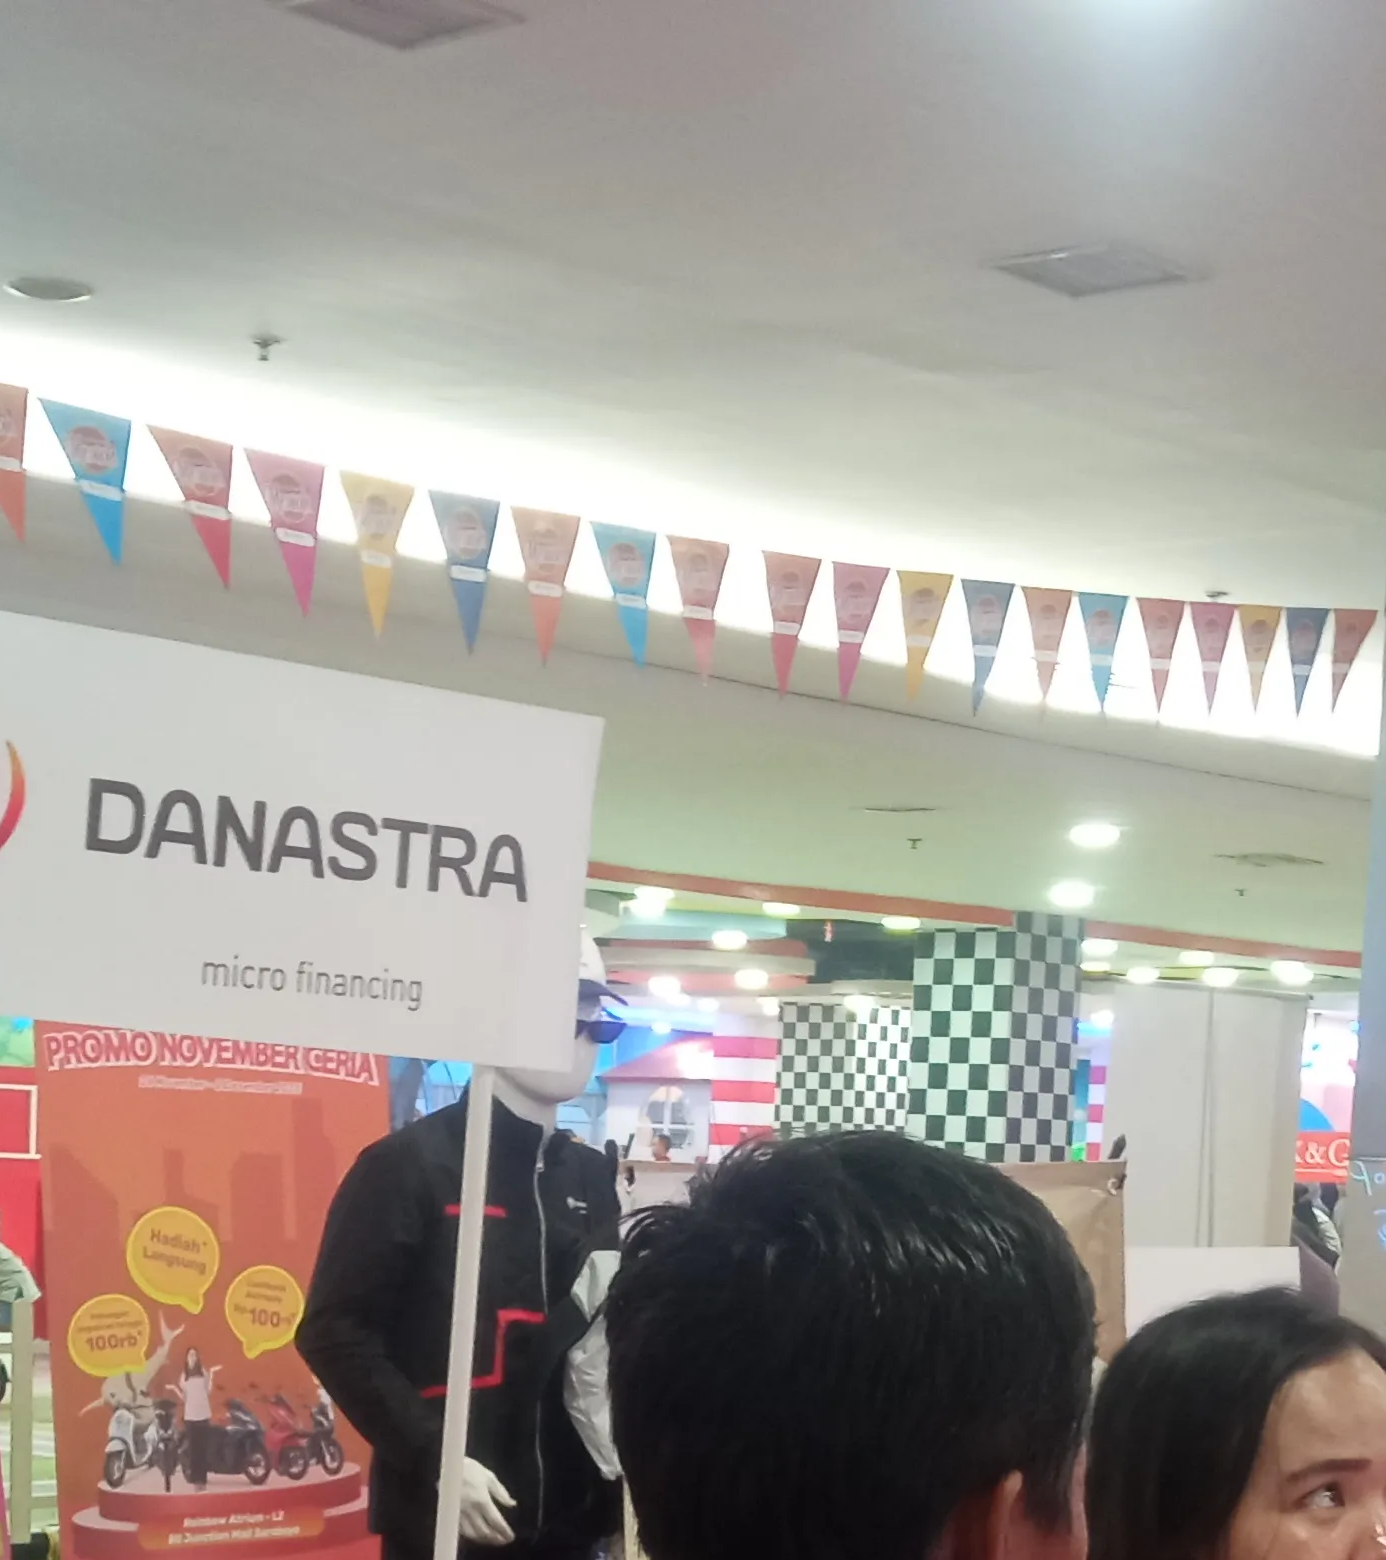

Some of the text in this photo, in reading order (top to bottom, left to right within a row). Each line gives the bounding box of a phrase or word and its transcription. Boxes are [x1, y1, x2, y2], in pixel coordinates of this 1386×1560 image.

[84, 777, 530, 903] DANASTRA
[201, 956, 424, 1012] micro financing
[44, 1030, 157, 1071] PROMO
[159, 1033, 300, 1072] NOVEMBER
[143, 1246, 206, 1275] Langsung
